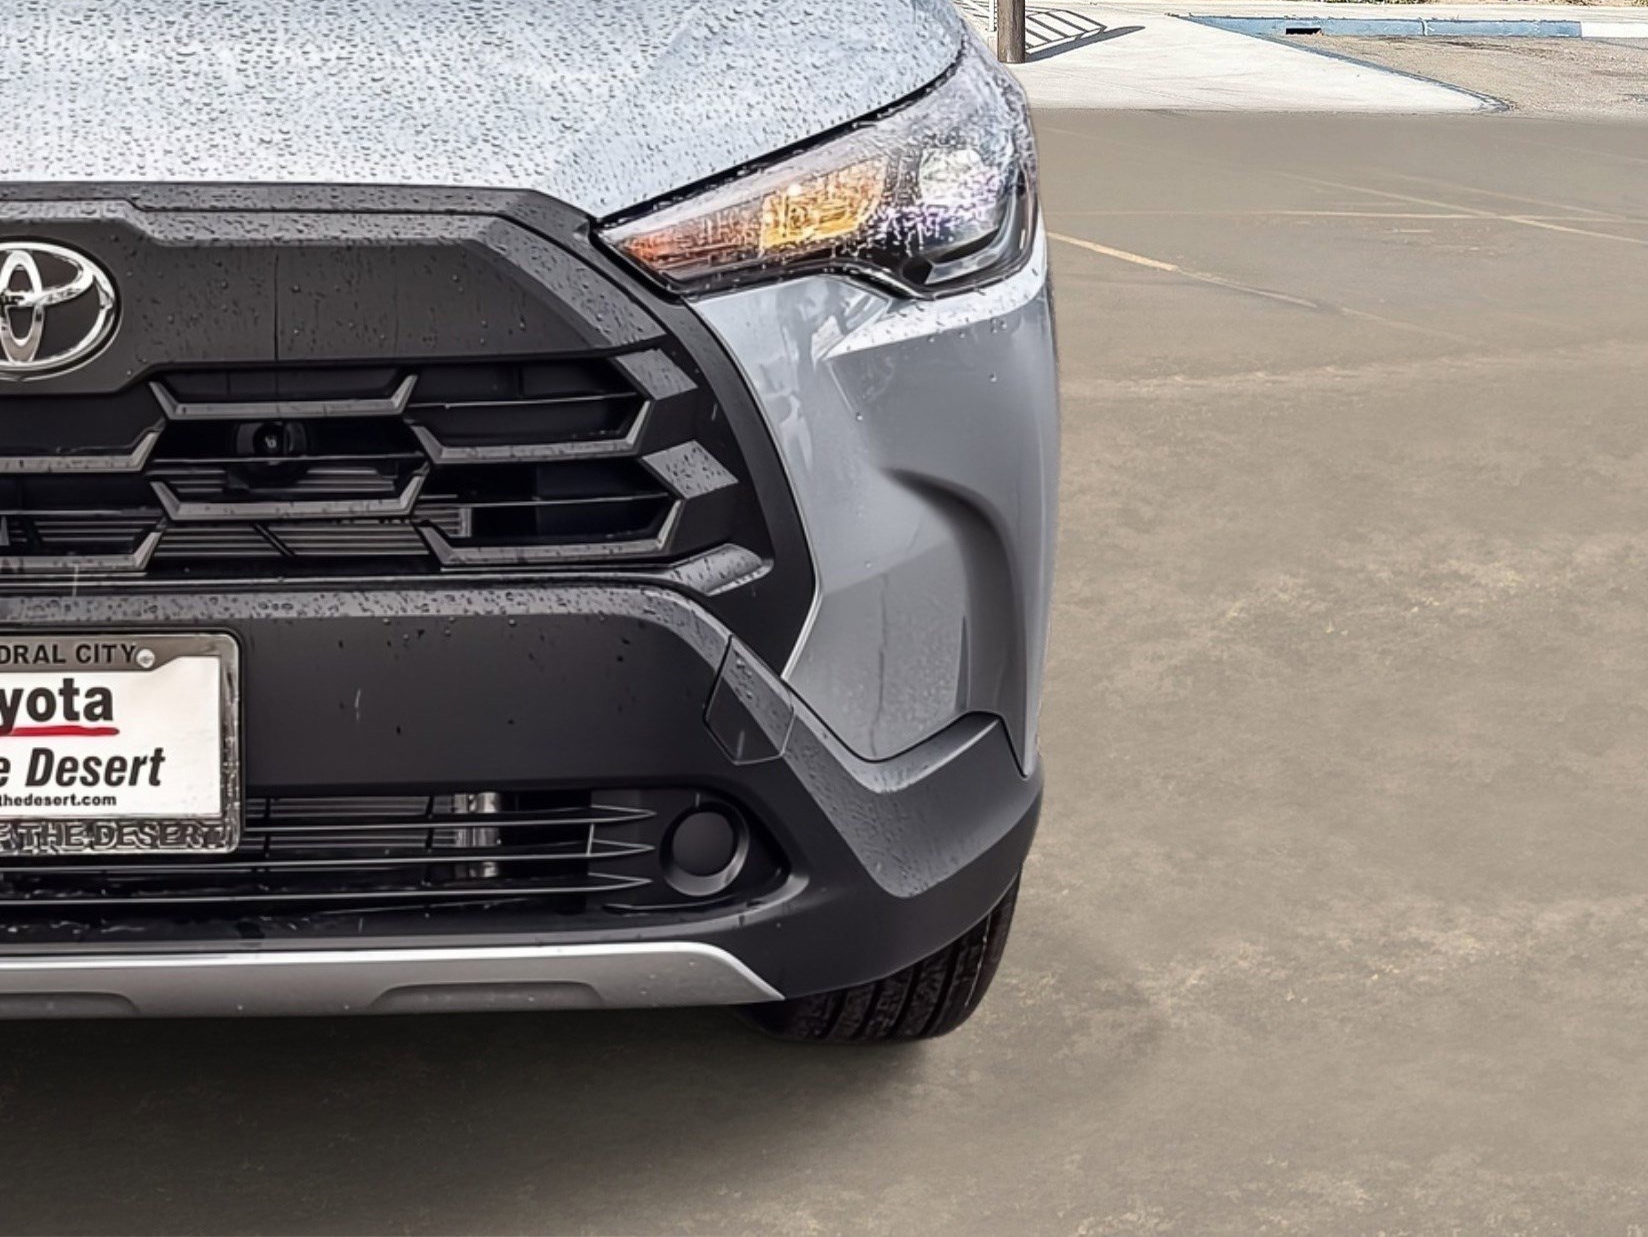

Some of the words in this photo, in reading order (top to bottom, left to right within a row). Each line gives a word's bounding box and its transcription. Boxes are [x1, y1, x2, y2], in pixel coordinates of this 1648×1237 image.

[75, 643, 137, 664] CITY
[25, 747, 166, 788] Desert
[18, 822, 88, 851] THE
[92, 822, 230, 850] DESERT
